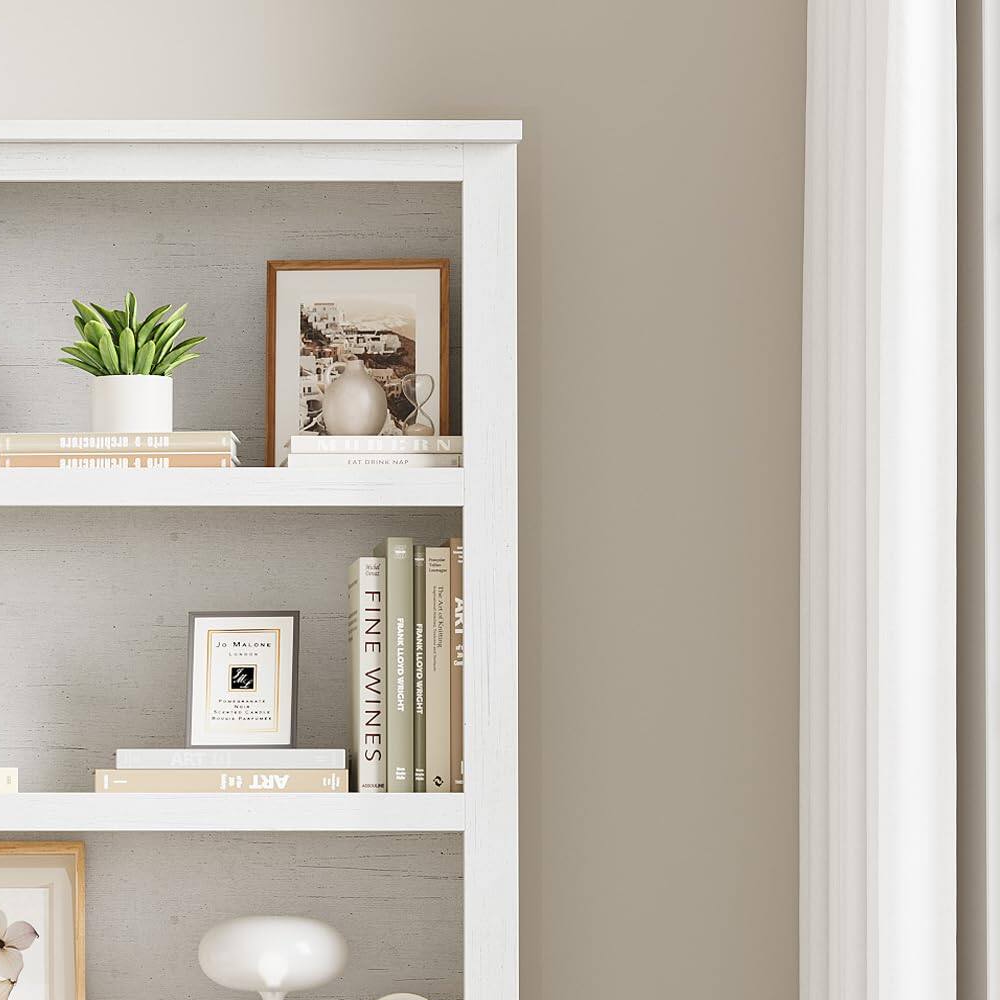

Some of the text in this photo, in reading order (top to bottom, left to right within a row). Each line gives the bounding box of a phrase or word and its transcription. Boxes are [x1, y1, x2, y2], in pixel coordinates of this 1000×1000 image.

[437, 586, 445, 598] The
[437, 599, 445, 611] Art
[365, 590, 382, 653] FINE
[436, 620, 445, 648] Knitting
[396, 617, 405, 712] FRANK LLOYD WRIGHT
[415, 623, 424, 715] FRANK LLOYD WRIGHT
[365, 667, 382, 762] WINES
[249, 774, 289, 790] ART
